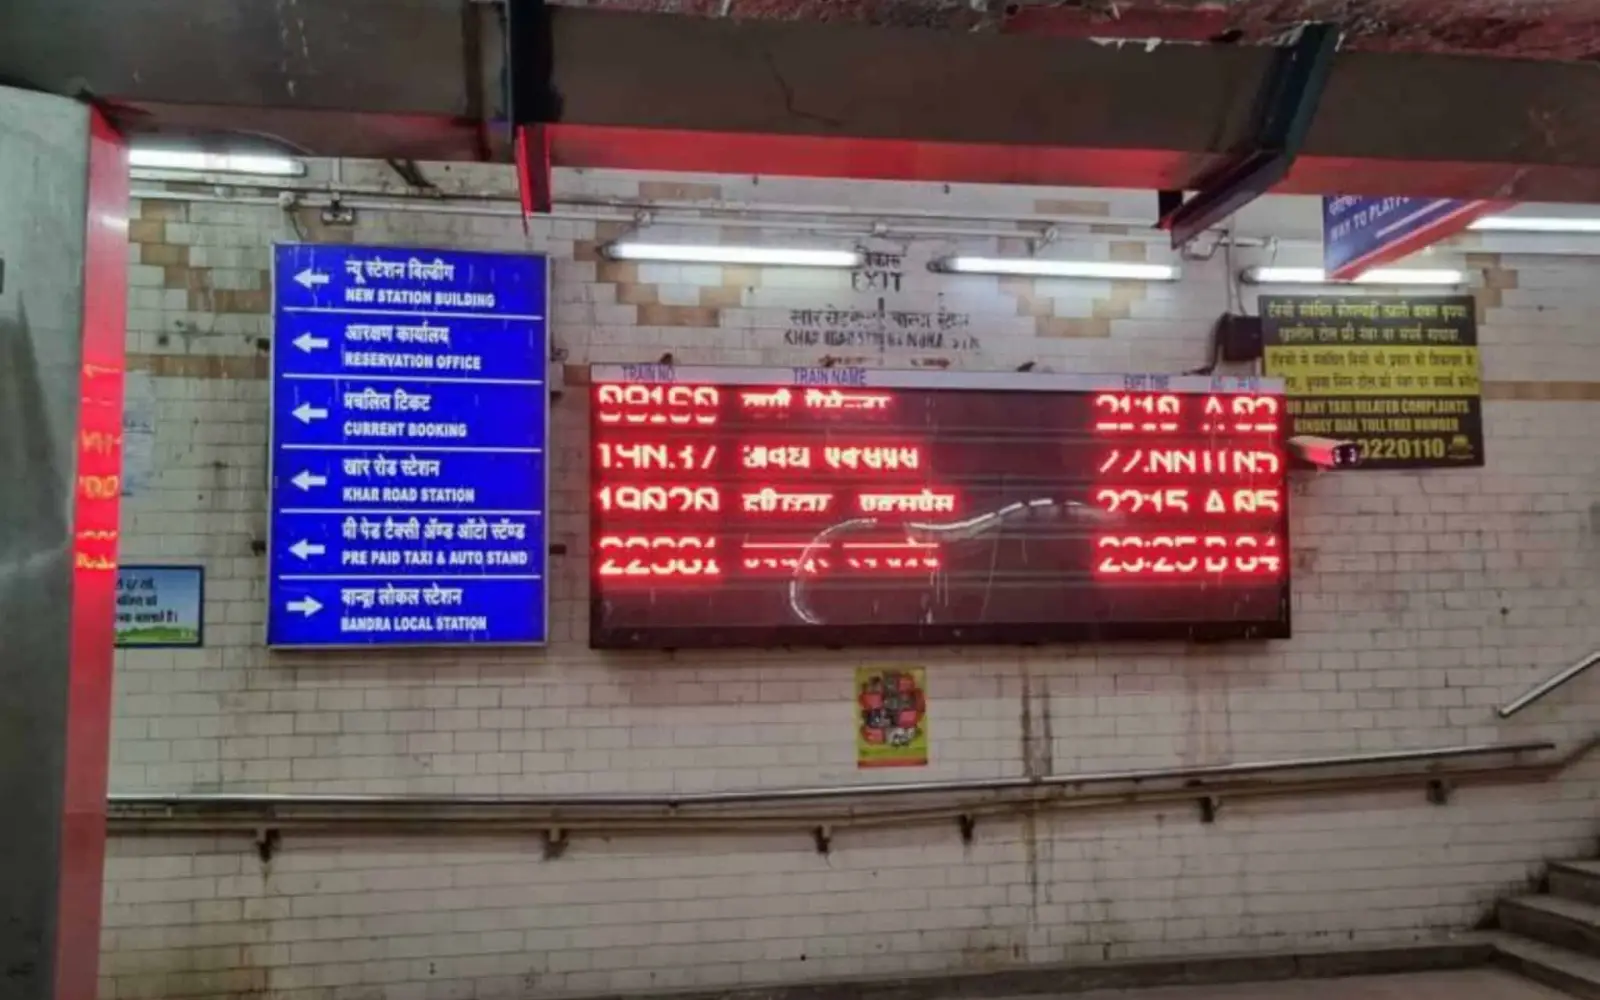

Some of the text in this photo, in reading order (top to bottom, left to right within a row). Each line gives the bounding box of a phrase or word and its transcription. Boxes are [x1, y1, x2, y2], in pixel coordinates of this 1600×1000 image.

[1353, 211, 1367, 229] TO
[365, 255, 405, 280] स्टेशन
[852, 271, 903, 293] EXIT
[345, 287, 496, 308] NEW STATION BUILDING
[344, 351, 482, 370] RESERVATION OFFICE
[793, 367, 868, 385] TRAIN NAME
[343, 421, 468, 438] CURRENT BOOKING
[373, 454, 398, 476] रोड
[400, 454, 440, 477] स्टेशन
[342, 487, 475, 503] KHAR ROAD STATION
[342, 550, 528, 566] PRE PAID TAXI & AUTO STAND
[422, 582, 463, 606] स्टेशन
[341, 615, 488, 631] BANDRA LOCAL STATION
